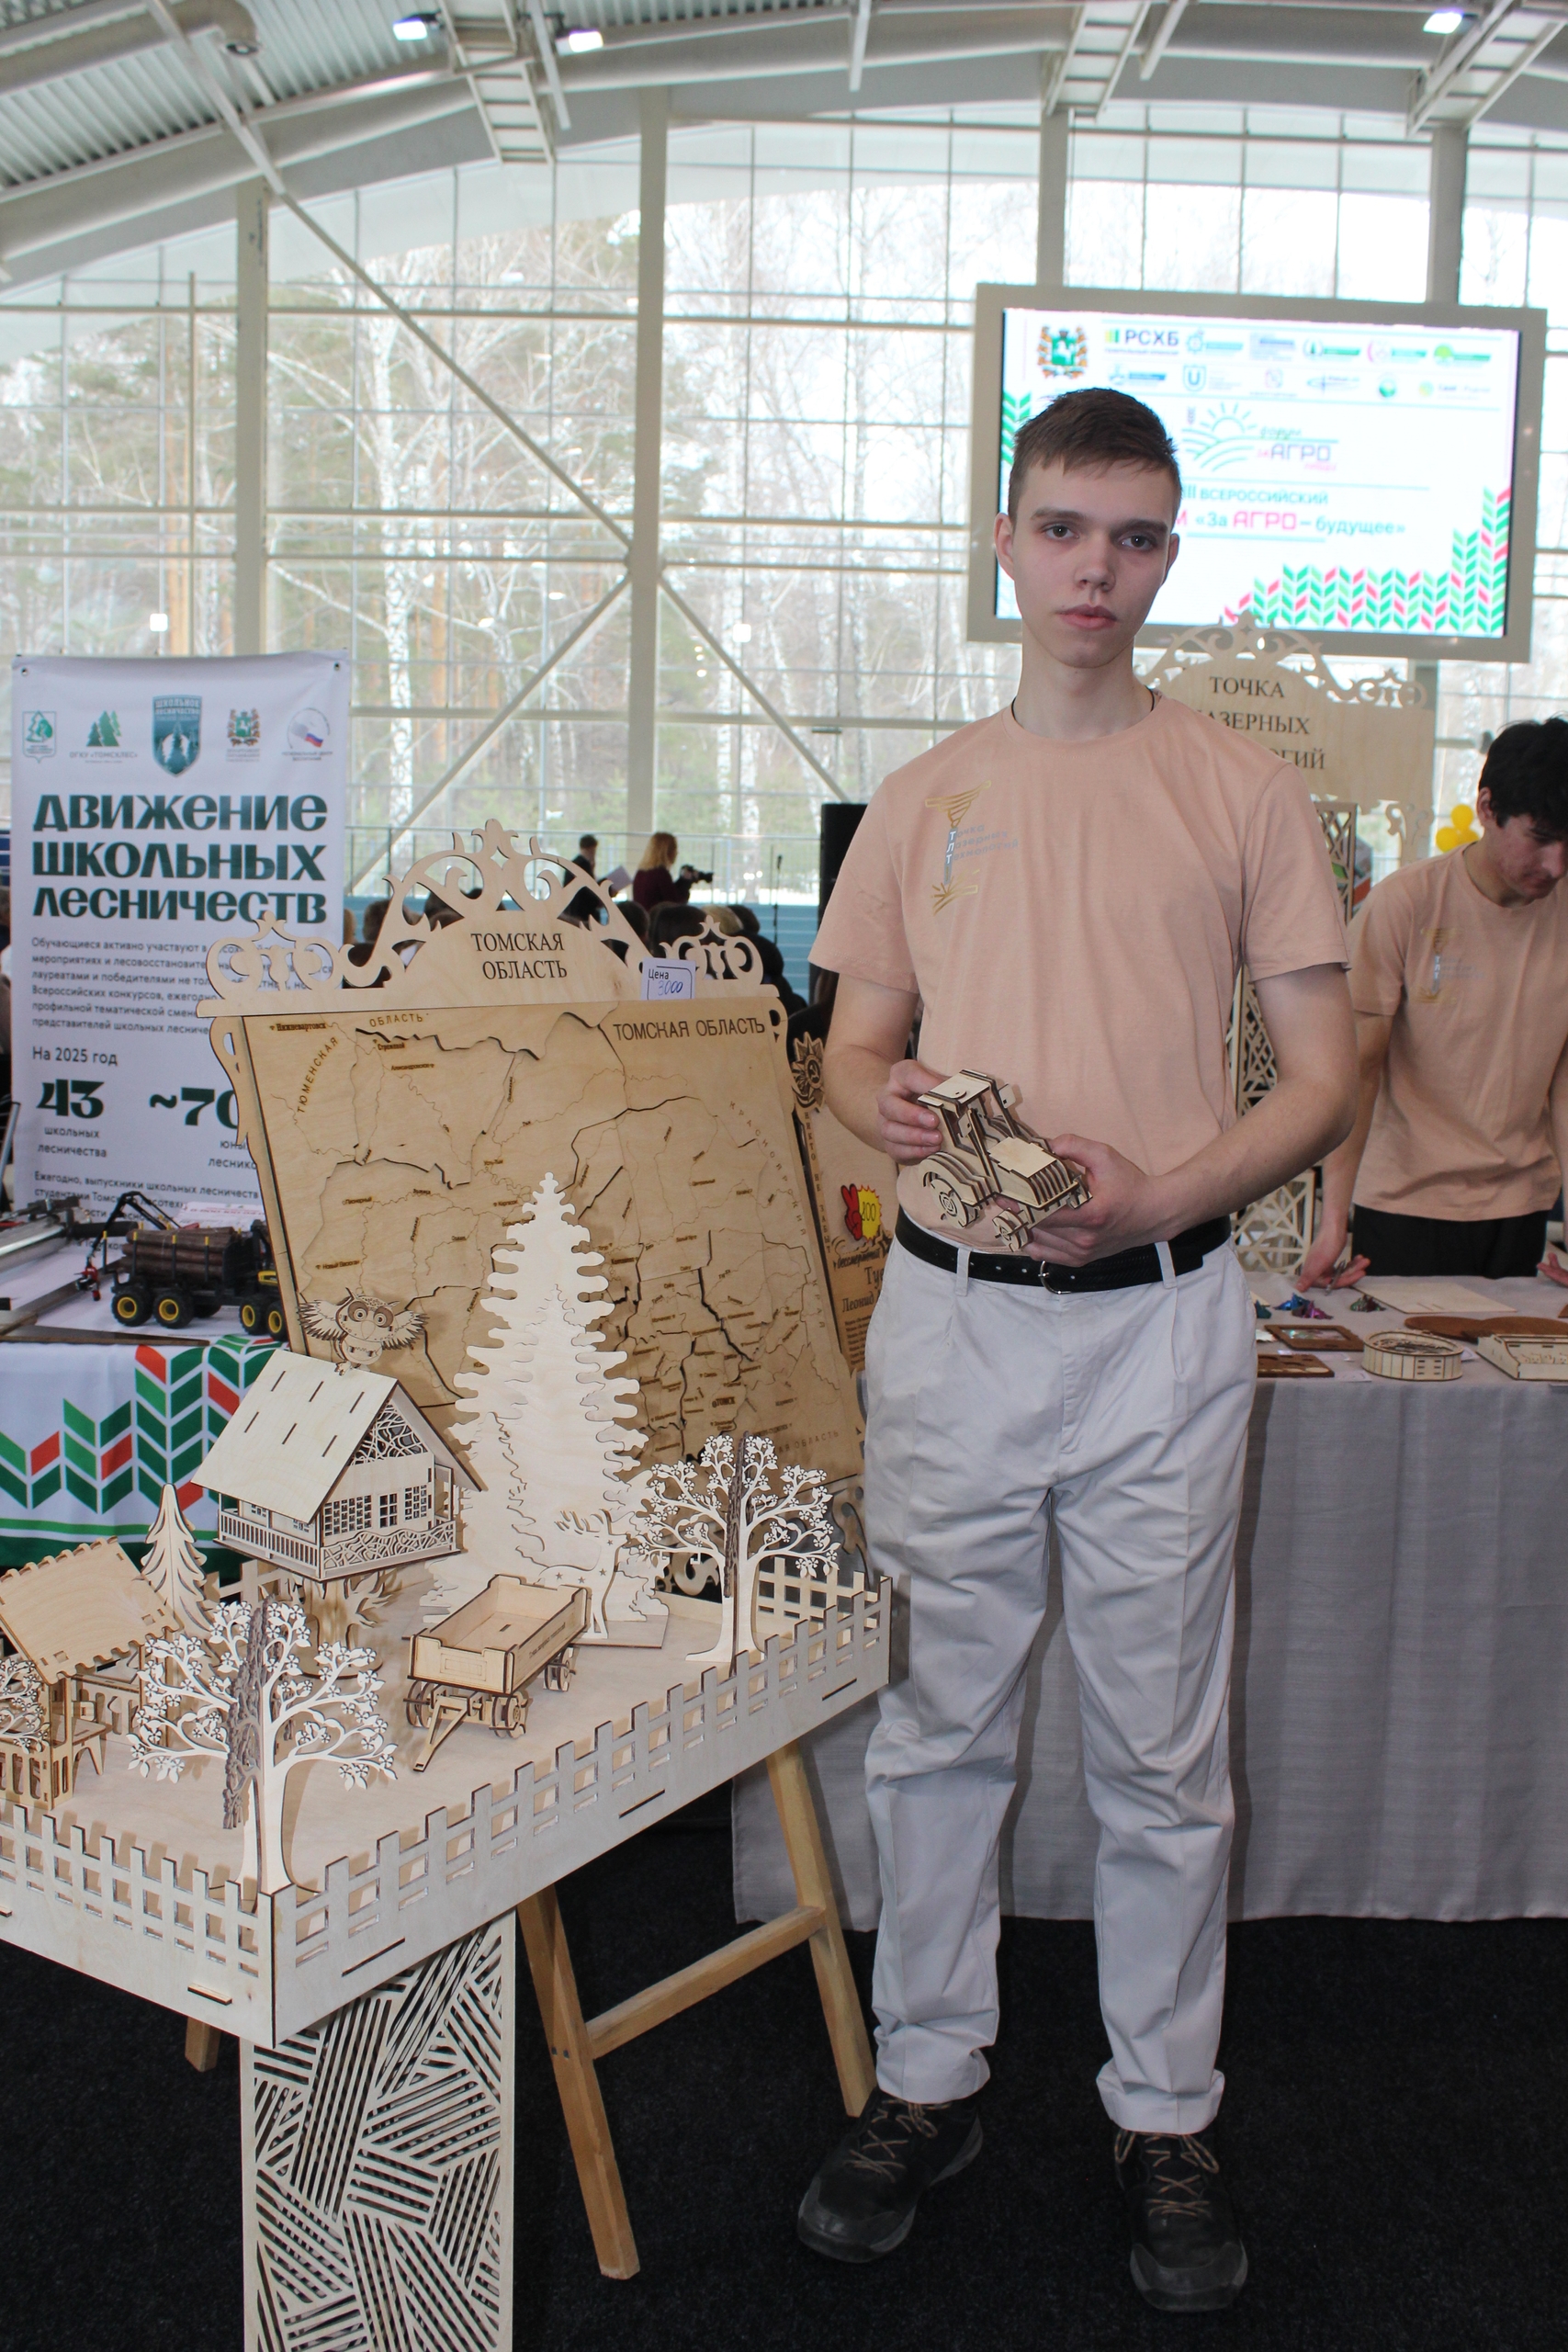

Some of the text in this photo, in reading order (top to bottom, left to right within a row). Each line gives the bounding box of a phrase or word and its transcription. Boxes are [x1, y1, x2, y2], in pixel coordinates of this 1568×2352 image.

[1125, 330, 1179, 346] РСХБ
[1270, 443, 1331, 461] АГРО
[1200, 487, 1328, 505] ВСЕРОССИЙСКИЙ
[1196, 512, 1227, 527] «За
[1233, 510, 1296, 530] АГРО
[1315, 516, 1405, 535] будущее»
[1209, 676, 1285, 697] ТОЧКА
[1197, 709, 1311, 734] ЗЕРНЫХ
[32, 794, 328, 831] ДВИЖЕНИЕ
[32, 842, 328, 881] ШКОЛЬНЫХ
[32, 887, 327, 924] ЛЕСНИЧЕСТВ
[31, 937, 100, 950] Обучающиеся
[103, 942, 144, 951] активно
[146, 944, 198, 953] участвуют
[470, 932, 565, 952] ТОМСКАЯ
[31, 956, 101, 966] мероприятиях
[482, 959, 568, 980] ОБЛАСТЬ
[31, 970, 89, 981] лауреатами
[101, 972, 175, 984] победителями
[649, 968, 669, 980] Цена
[31, 985, 217, 1002] Всероссийских конкурсов, ежегодно
[658, 980, 683, 996] 3000
[31, 1002, 91, 1012] профильной
[94, 1003, 164, 1015] тематической
[31, 1017, 209, 1035] представителей школьных лесниче
[276, 1022, 326, 1032] Нижневартовск
[369, 1012, 423, 1028] ОБЛАСТЬ
[613, 1017, 765, 1042] ТОМСКАЯ ОБЛАСТЬ
[32, 1046, 118, 1066] На 2025 год
[297, 1036, 339, 1114] ТЮМЕНСКАЯ
[36, 1079, 105, 1119] 43
[44, 1126, 99, 1138] школьных
[38, 1144, 107, 1158] лесничества
[220, 1140, 247, 1149] юны
[208, 1158, 257, 1170] леснико
[34, 1171, 259, 1199] Ежегодно, выпускники школьных лесничеств
[841, 1290, 874, 1313] Леонид
